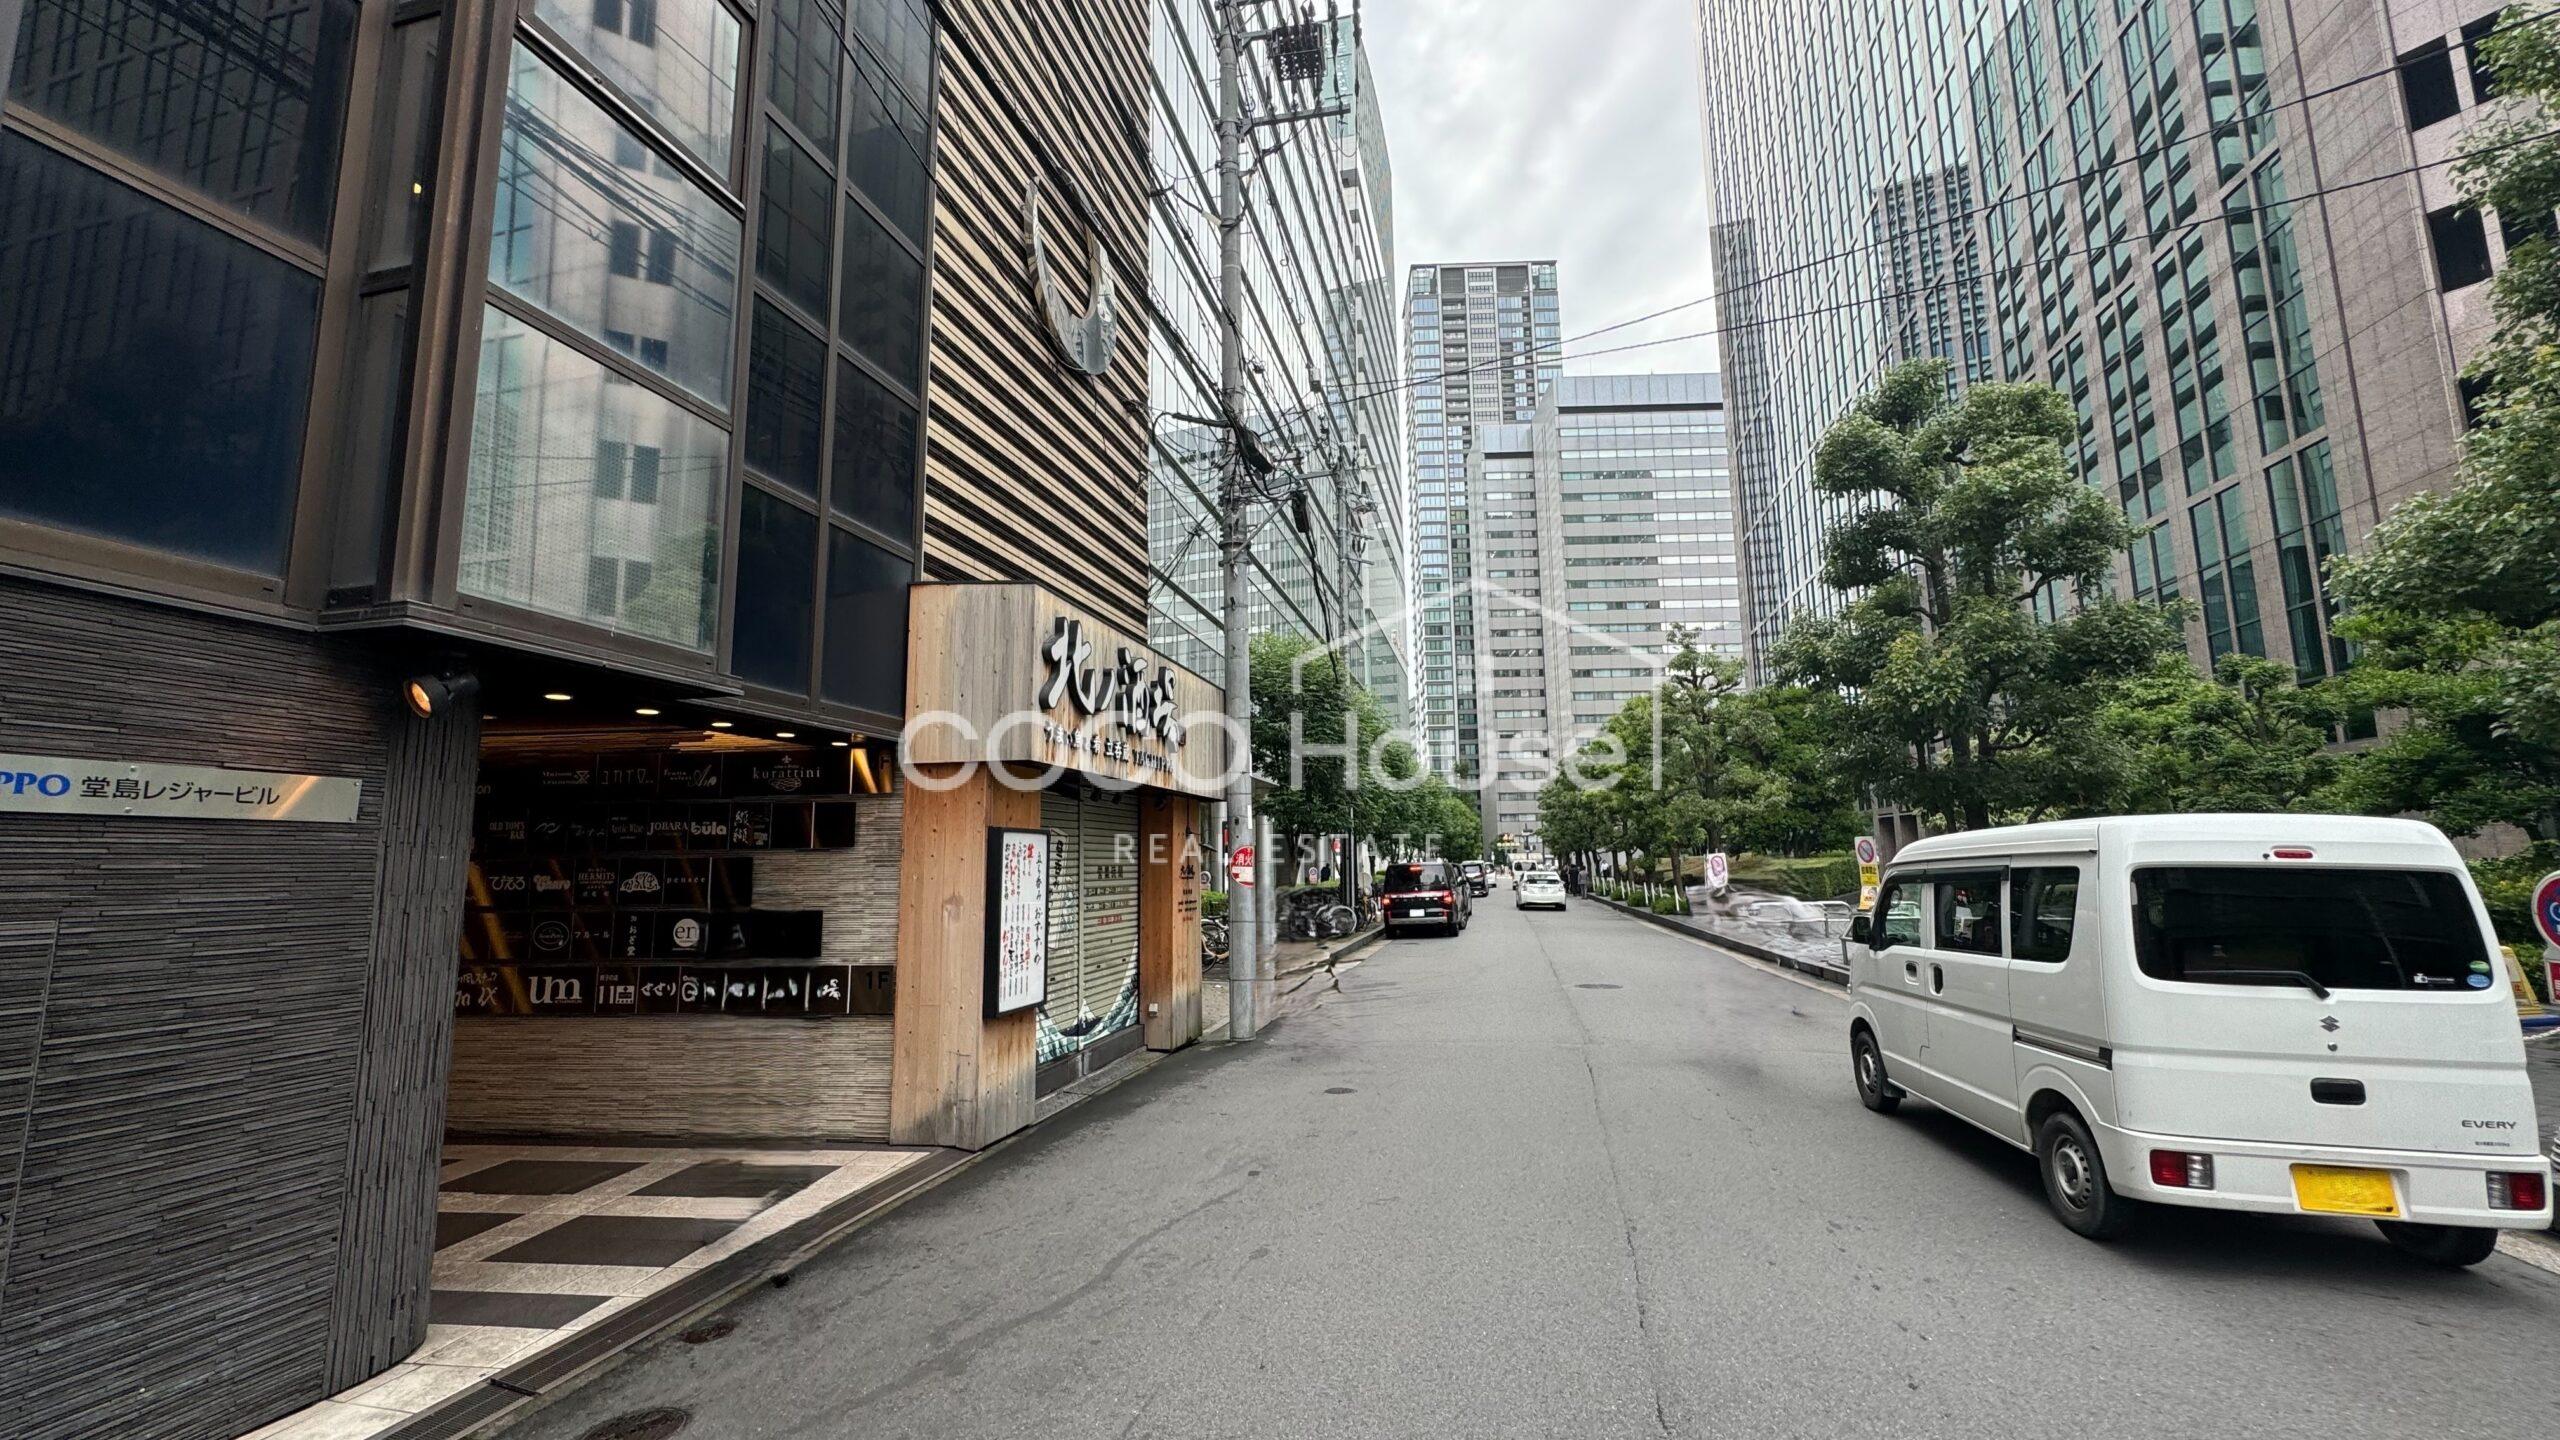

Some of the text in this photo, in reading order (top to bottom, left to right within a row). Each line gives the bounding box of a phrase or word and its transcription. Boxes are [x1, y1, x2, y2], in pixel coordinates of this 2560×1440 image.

[80, 776, 281, 805] 堂島レジャービル
[646, 821, 688, 836] JOBARA
[528, 976, 583, 1004] um
[866, 971, 889, 990] 1F
[2461, 1119, 2517, 1130] EVERY
